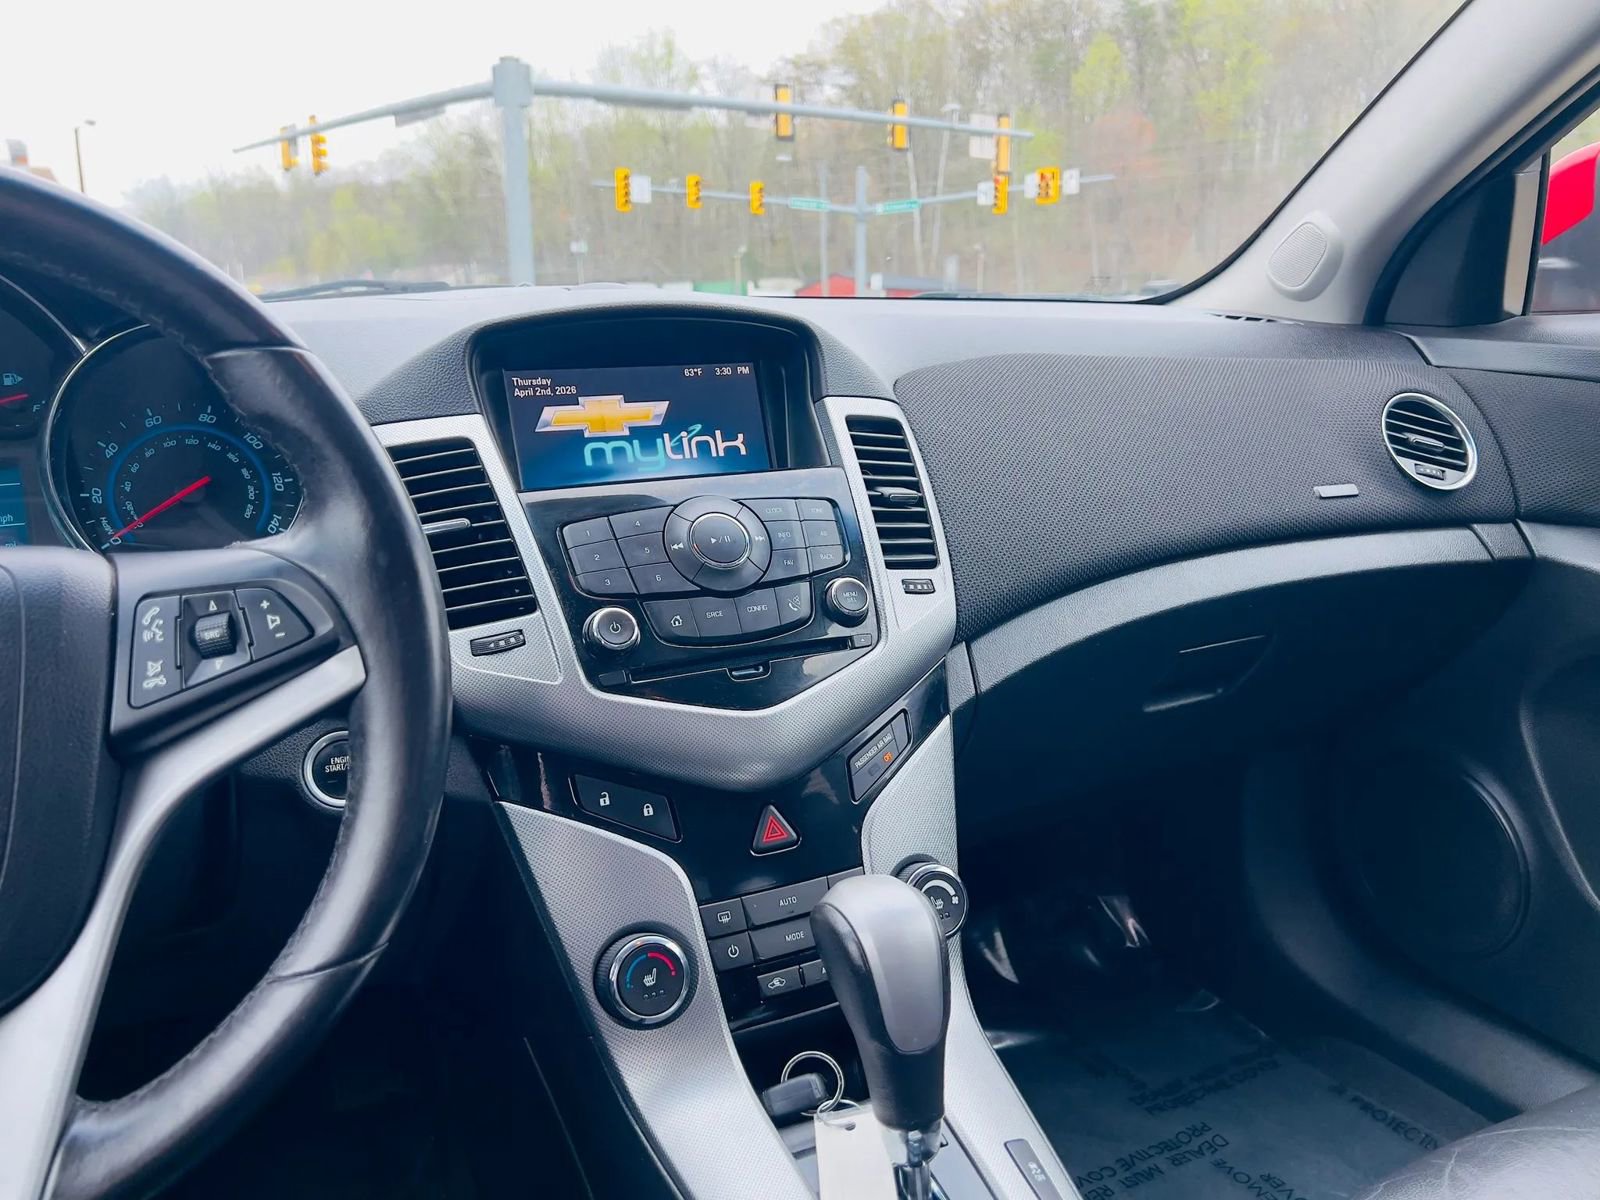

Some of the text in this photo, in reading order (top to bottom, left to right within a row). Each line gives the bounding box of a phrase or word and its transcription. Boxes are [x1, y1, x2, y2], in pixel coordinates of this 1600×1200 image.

[714, 367, 732, 376] 3:30
[737, 366, 750, 375] PM
[511, 377, 552, 386] Thursday
[514, 385, 577, 399] April 2nd, 2026
[33, 404, 40, 412] F
[145, 415, 162, 427] 60
[198, 413, 216, 423] 80
[163, 439, 177, 448] 100
[207, 441, 221, 451] 140
[243, 432, 263, 450] 100
[105, 442, 119, 458] 40
[144, 448, 155, 458] 80
[130, 462, 140, 473] 60
[124, 481, 132, 492] 40
[272, 472, 285, 492] 120
[91, 487, 103, 504] 20
[100, 516, 115, 535] MPH
[267, 513, 282, 534] 140
[110, 536, 122, 545] 0
[655, 574, 662, 582] 6
[746, 604, 768, 613] CONFIG
[706, 610, 723, 619] SRCE
[204, 630, 221, 640] SRC
[883, 751, 893, 762] OFF
[779, 896, 797, 907] AUTO
[785, 930, 805, 942] MODE
[1075, 1121, 1213, 1190] PROTECTIVE COV
[1165, 1133, 1230, 1167] DEALER
[1118, 1163, 1165, 1189] MUST
[1259, 1172, 1307, 1200] VER
